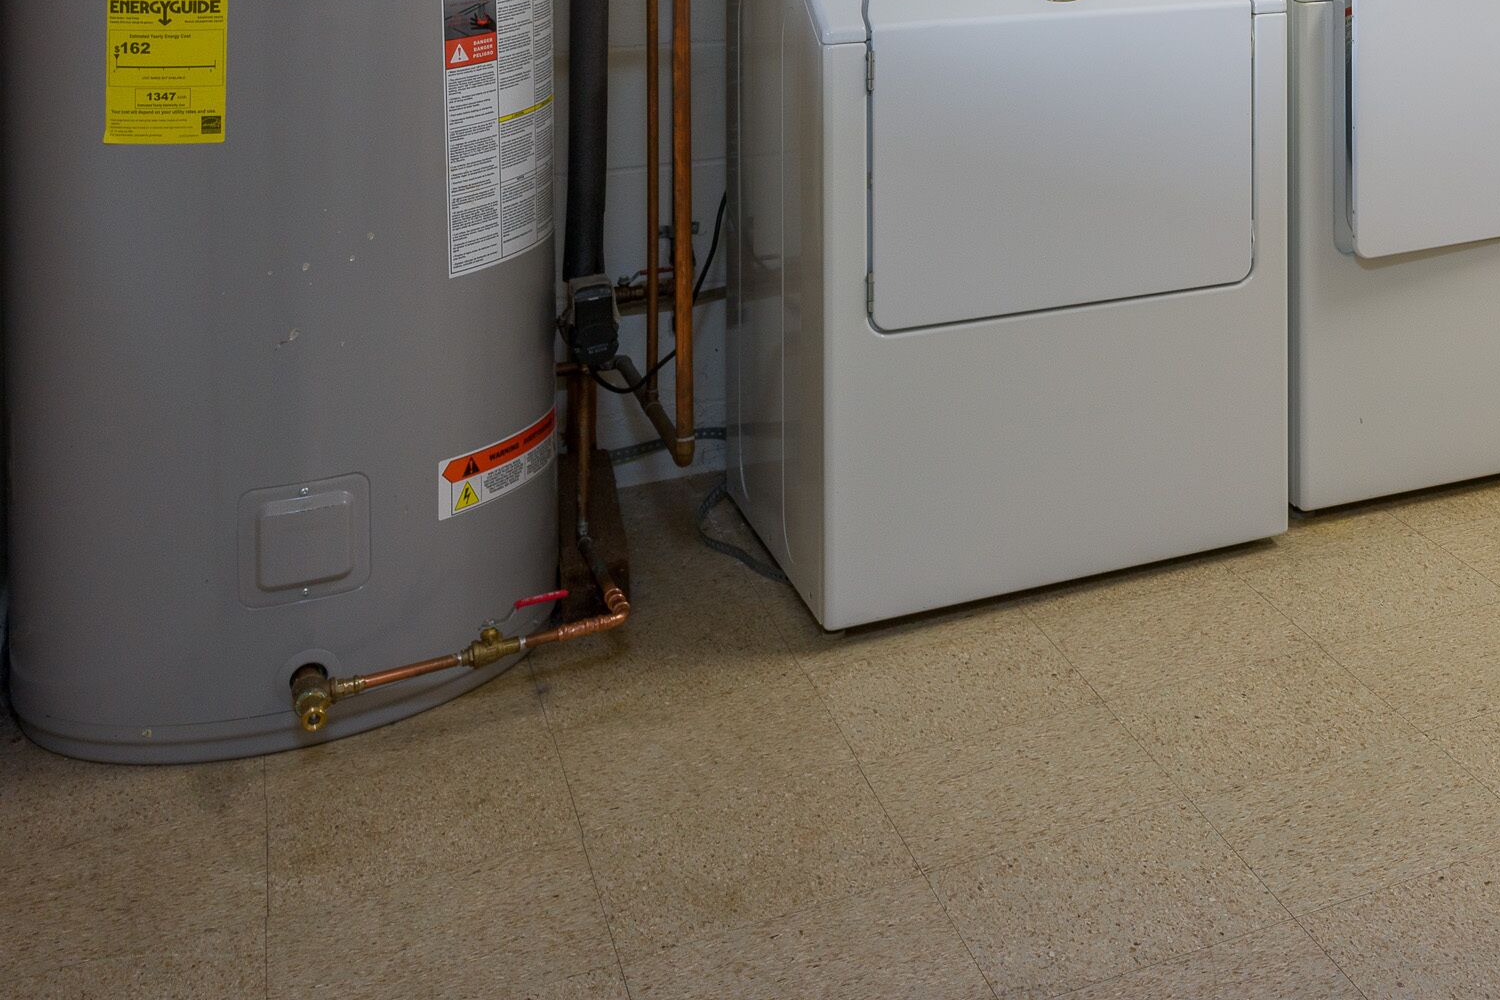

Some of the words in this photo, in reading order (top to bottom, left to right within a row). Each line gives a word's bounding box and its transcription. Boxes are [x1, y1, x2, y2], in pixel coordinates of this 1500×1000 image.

[110, 0, 221, 15] ENERGYGUIDE
[473, 38, 493, 47] DANGER
[114, 42, 151, 54] $162
[473, 44, 494, 53] DANGER
[472, 51, 494, 60] PELIGRO
[146, 92, 177, 101] 1347
[489, 441, 520, 462] WARNING
